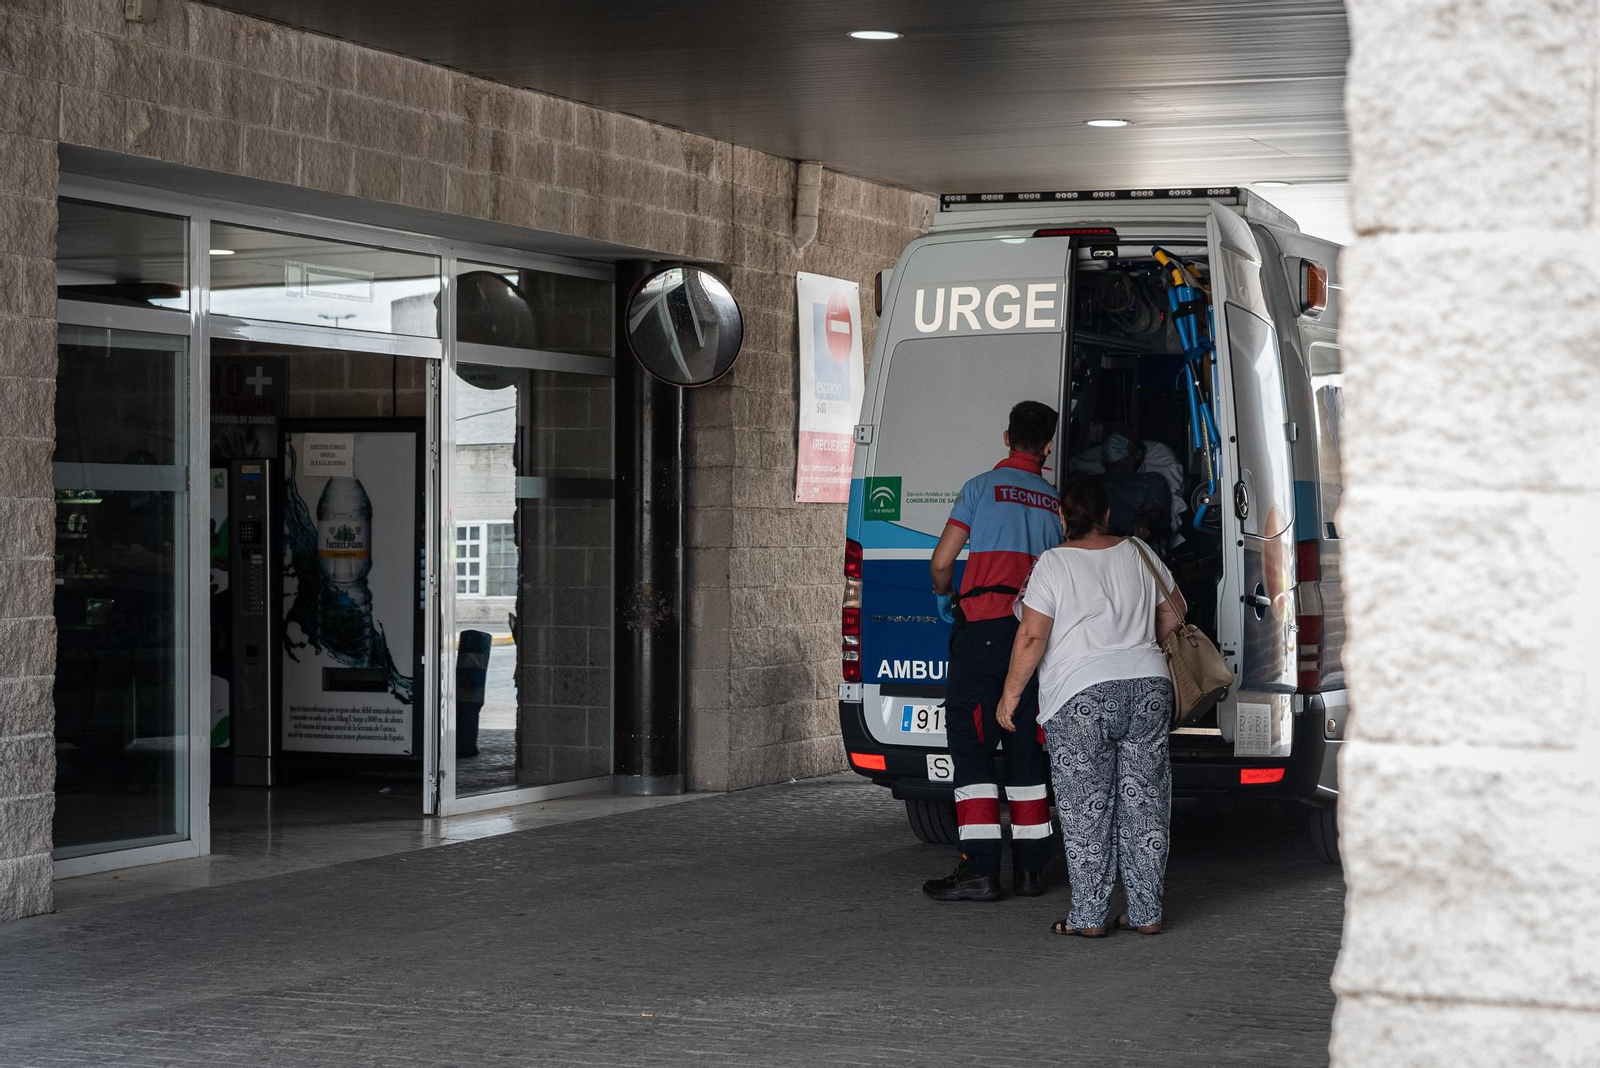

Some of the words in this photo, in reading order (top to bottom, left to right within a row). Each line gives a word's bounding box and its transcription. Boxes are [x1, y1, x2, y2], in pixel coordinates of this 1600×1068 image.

[914, 283, 1065, 333] URGE
[816, 381, 842, 398] espacio
[816, 401, 827, 414] sin
[1000, 487, 1059, 511] TÉCNICO
[870, 615, 938, 624] SPRINTER
[917, 709, 946, 730] 91
[934, 758, 950, 778] S
